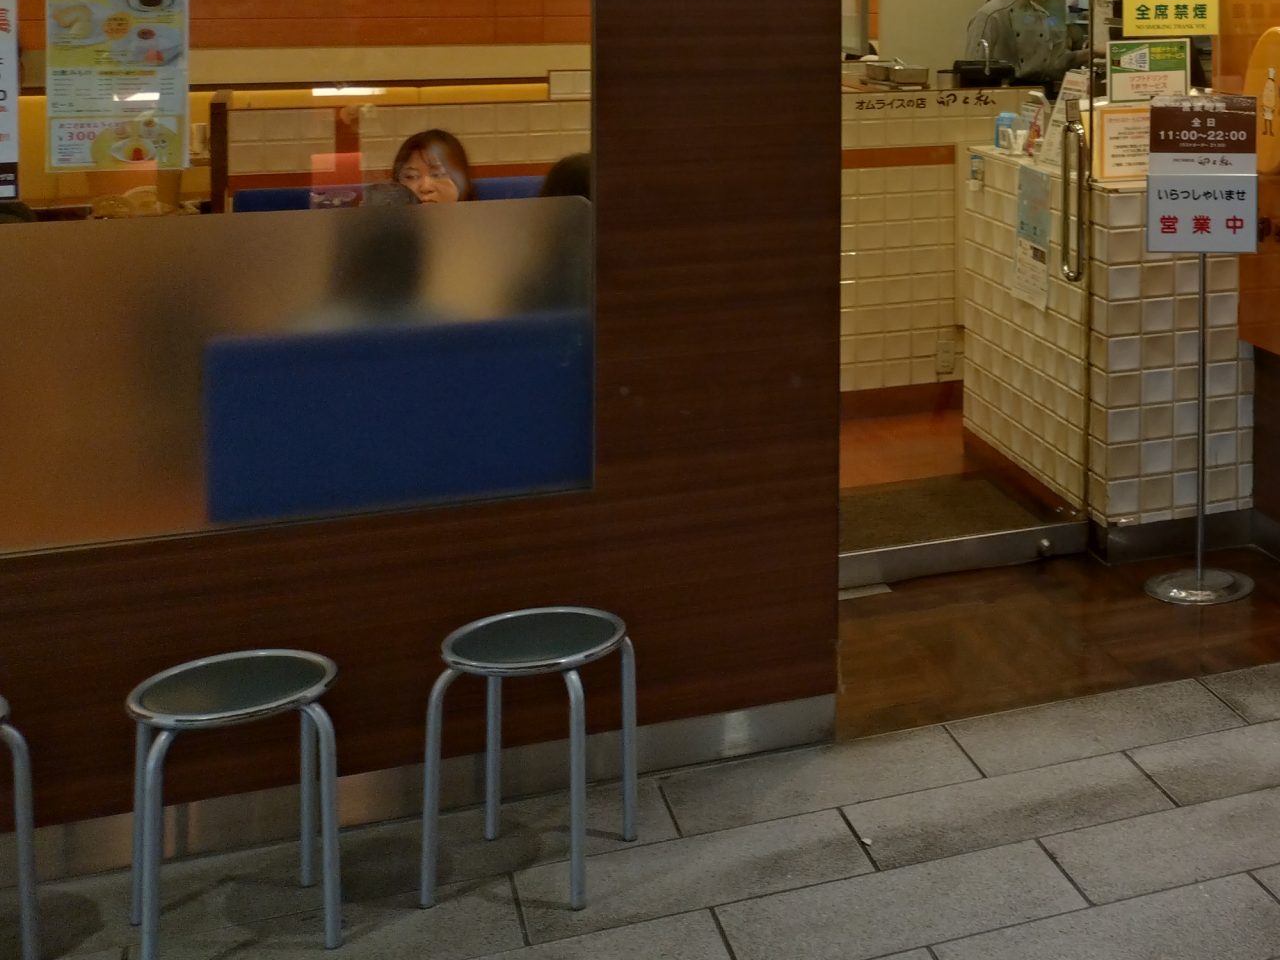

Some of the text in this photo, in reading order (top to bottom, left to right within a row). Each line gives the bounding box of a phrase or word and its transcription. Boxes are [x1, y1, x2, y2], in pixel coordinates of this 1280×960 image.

[1136, 4, 1208, 20] 全席禁煙
[855, 91, 996, 110] オムライスの店 卵と私
[1191, 117, 1215, 127] 全日
[1157, 189, 1247, 201] いらっしゃいませ
[1160, 215, 1244, 234] 営業中
